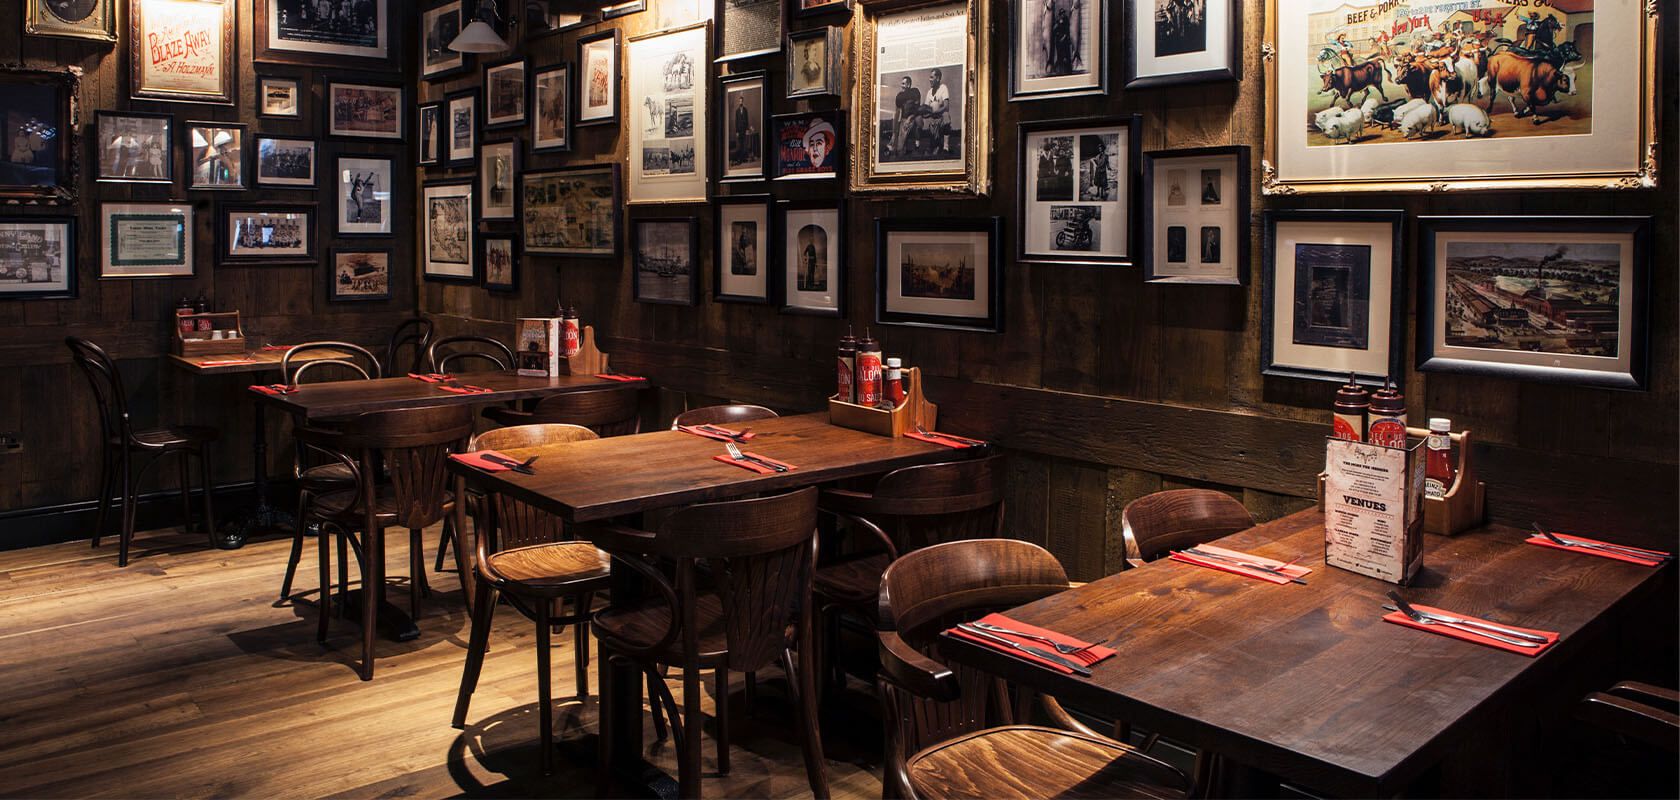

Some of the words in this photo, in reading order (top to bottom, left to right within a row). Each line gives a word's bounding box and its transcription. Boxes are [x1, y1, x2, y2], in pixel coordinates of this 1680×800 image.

[1347, 10, 1369, 25] BEEF
[1370, 8, 1378, 19] &
[1391, 20, 1408, 40] New
[1406, 14, 1433, 34] York
[148, 32, 184, 65] BLAZE
[1343, 495, 1386, 511] VENUES
